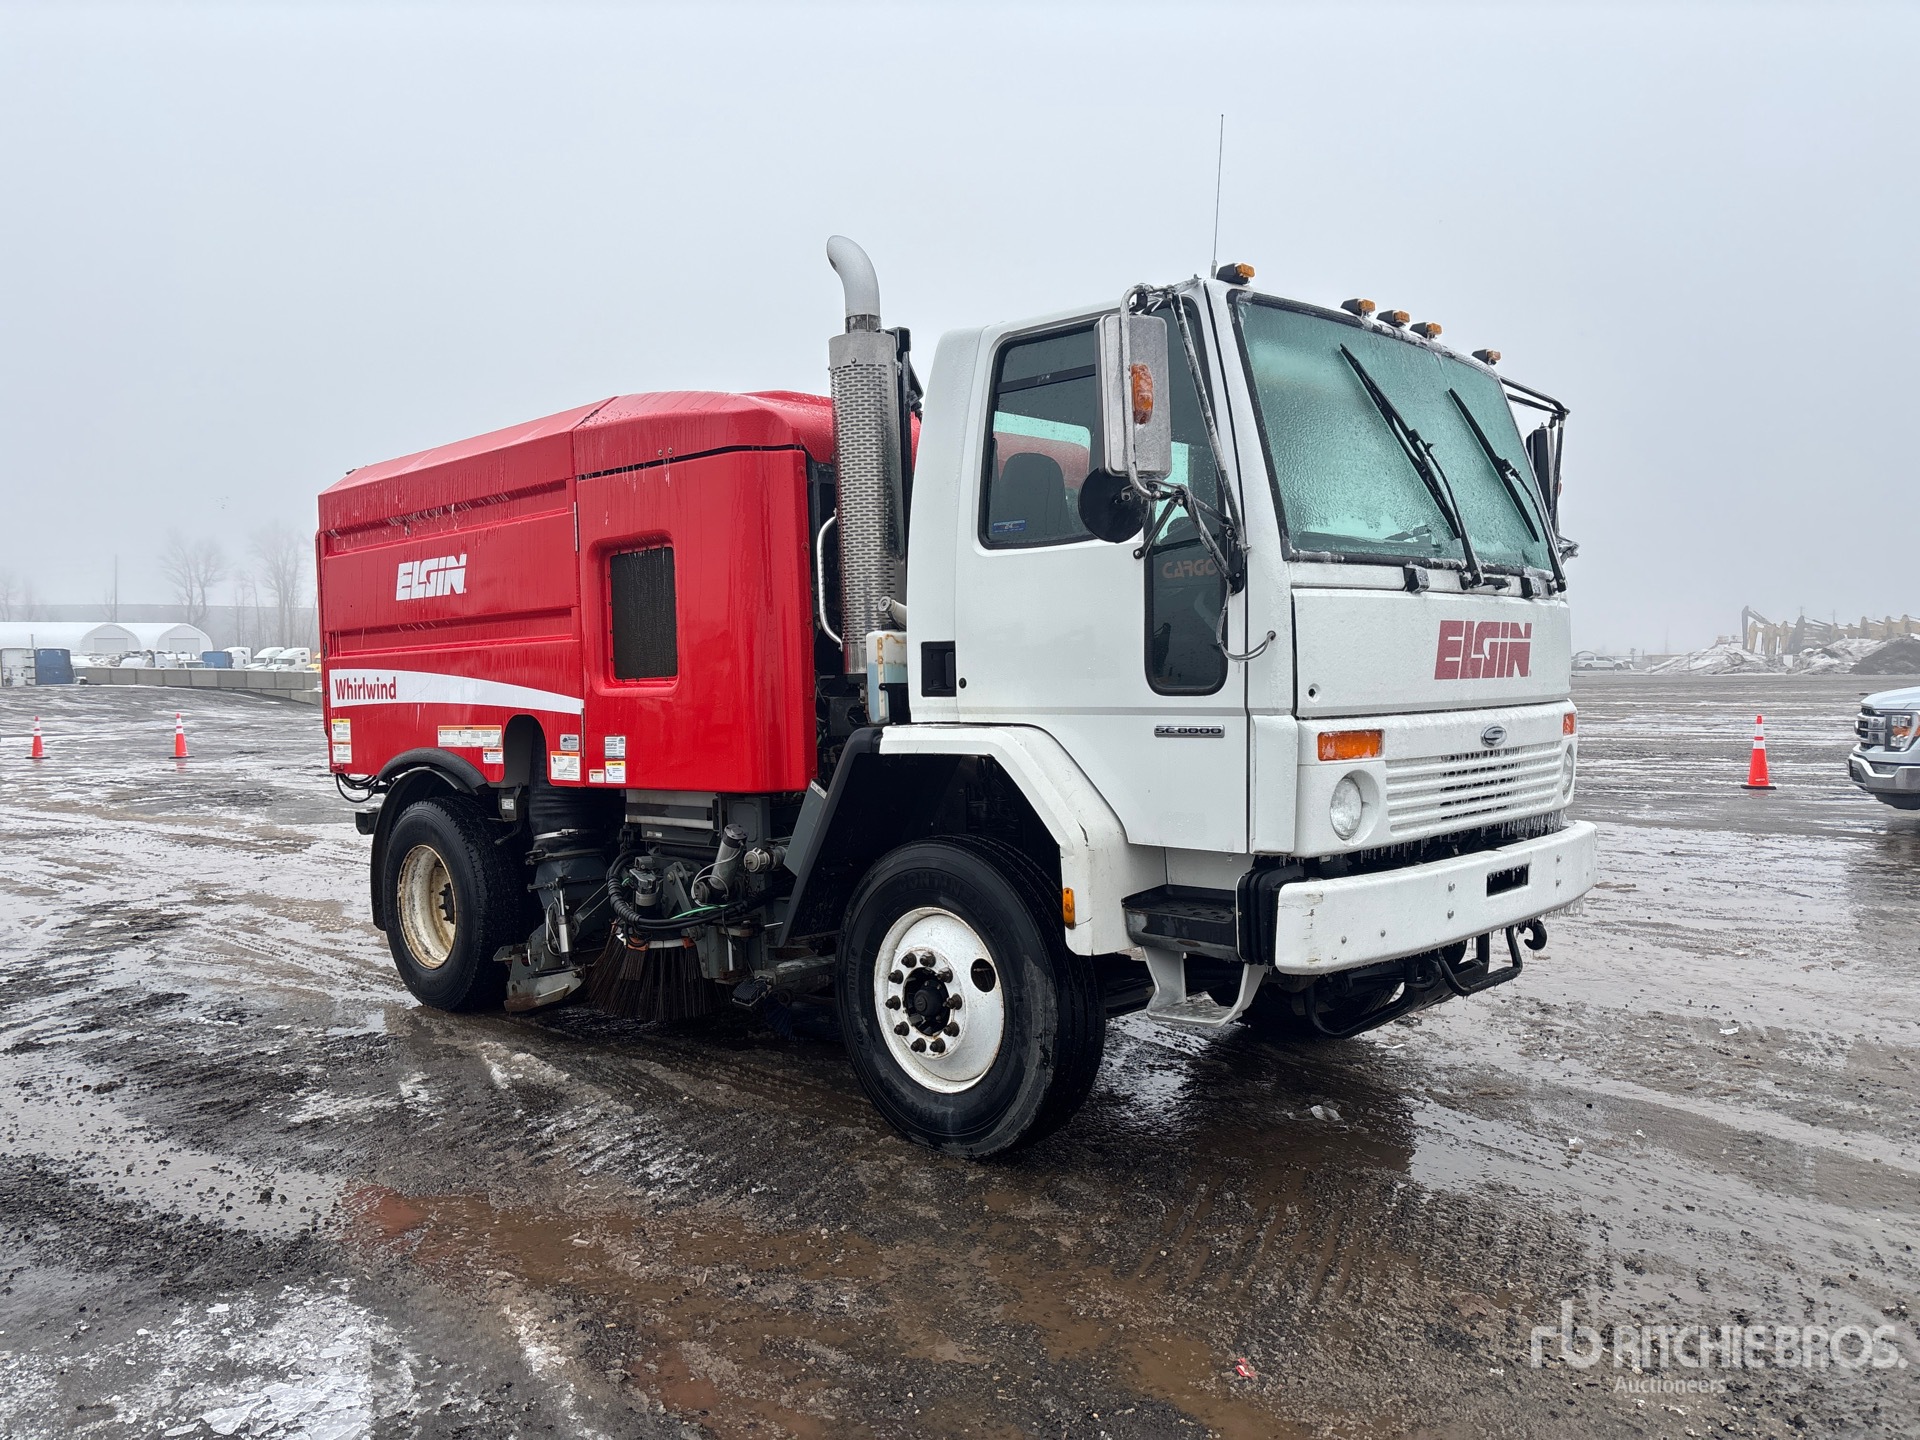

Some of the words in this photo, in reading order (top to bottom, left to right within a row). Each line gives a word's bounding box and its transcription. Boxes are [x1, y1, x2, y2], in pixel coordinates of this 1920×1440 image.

[395, 553, 467, 601] ELGIN
[1162, 559, 1217, 579] CARGO
[1434, 620, 1532, 680] ELGIN
[334, 676, 397, 700] Whirlwind
